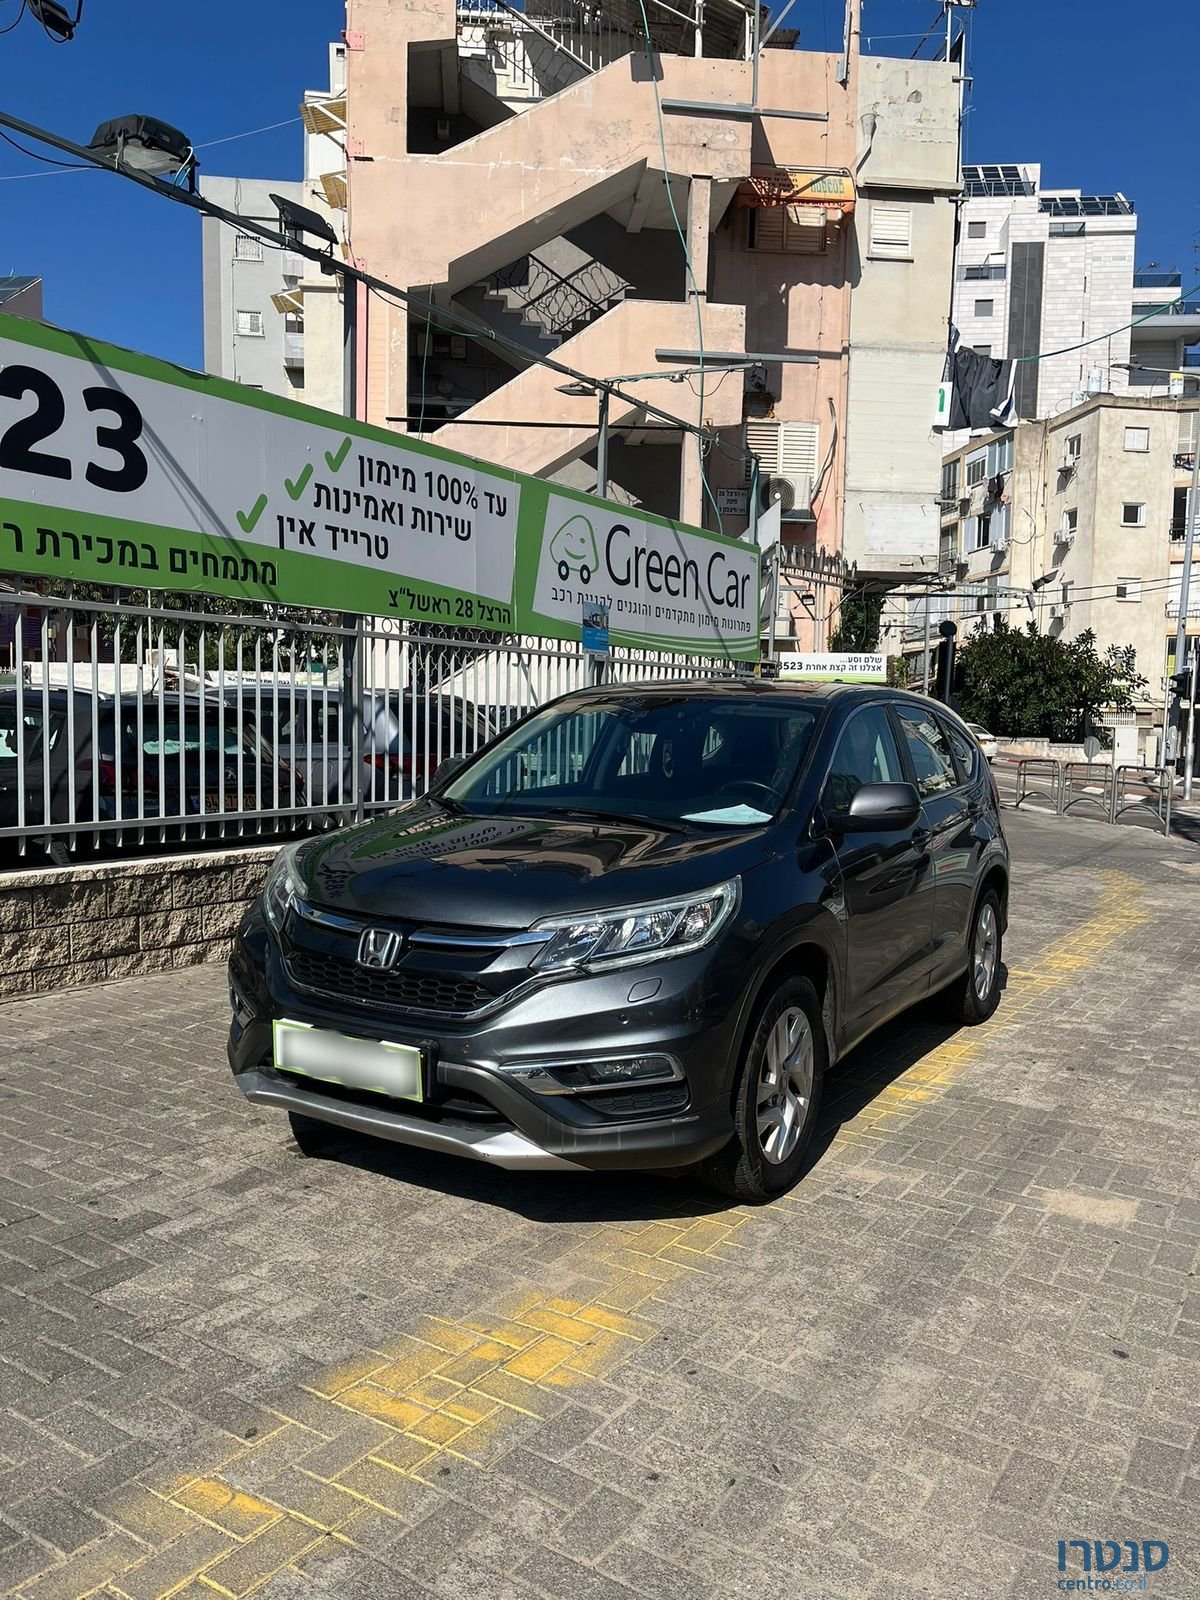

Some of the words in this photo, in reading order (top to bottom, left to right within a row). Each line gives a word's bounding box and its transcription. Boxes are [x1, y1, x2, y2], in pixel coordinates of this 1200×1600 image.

[0, 365, 148, 492] 23
[358, 454, 416, 494] מימון
[424, 471, 479, 510] 100%
[313, 482, 404, 527] ואמינות
[484, 491, 507, 517] עד
[277, 514, 316, 550] אין
[411, 506, 472, 541] שירות
[36, 527, 159, 571] במכירת
[325, 525, 389, 560] טרייד
[169, 547, 278, 586] מתמחים
[605, 524, 699, 601] Green
[707, 551, 750, 609] Car
[455, 597, 474, 619] 28
[551, 586, 573, 601] רכב
[617, 599, 651, 617] והוגנים
[477, 600, 511, 625] הרצל
[655, 605, 695, 625] מתקדמים
[698, 613, 719, 628] מימון
[721, 619, 751, 633] פתרונות
[863, 655, 883, 664] שלם
